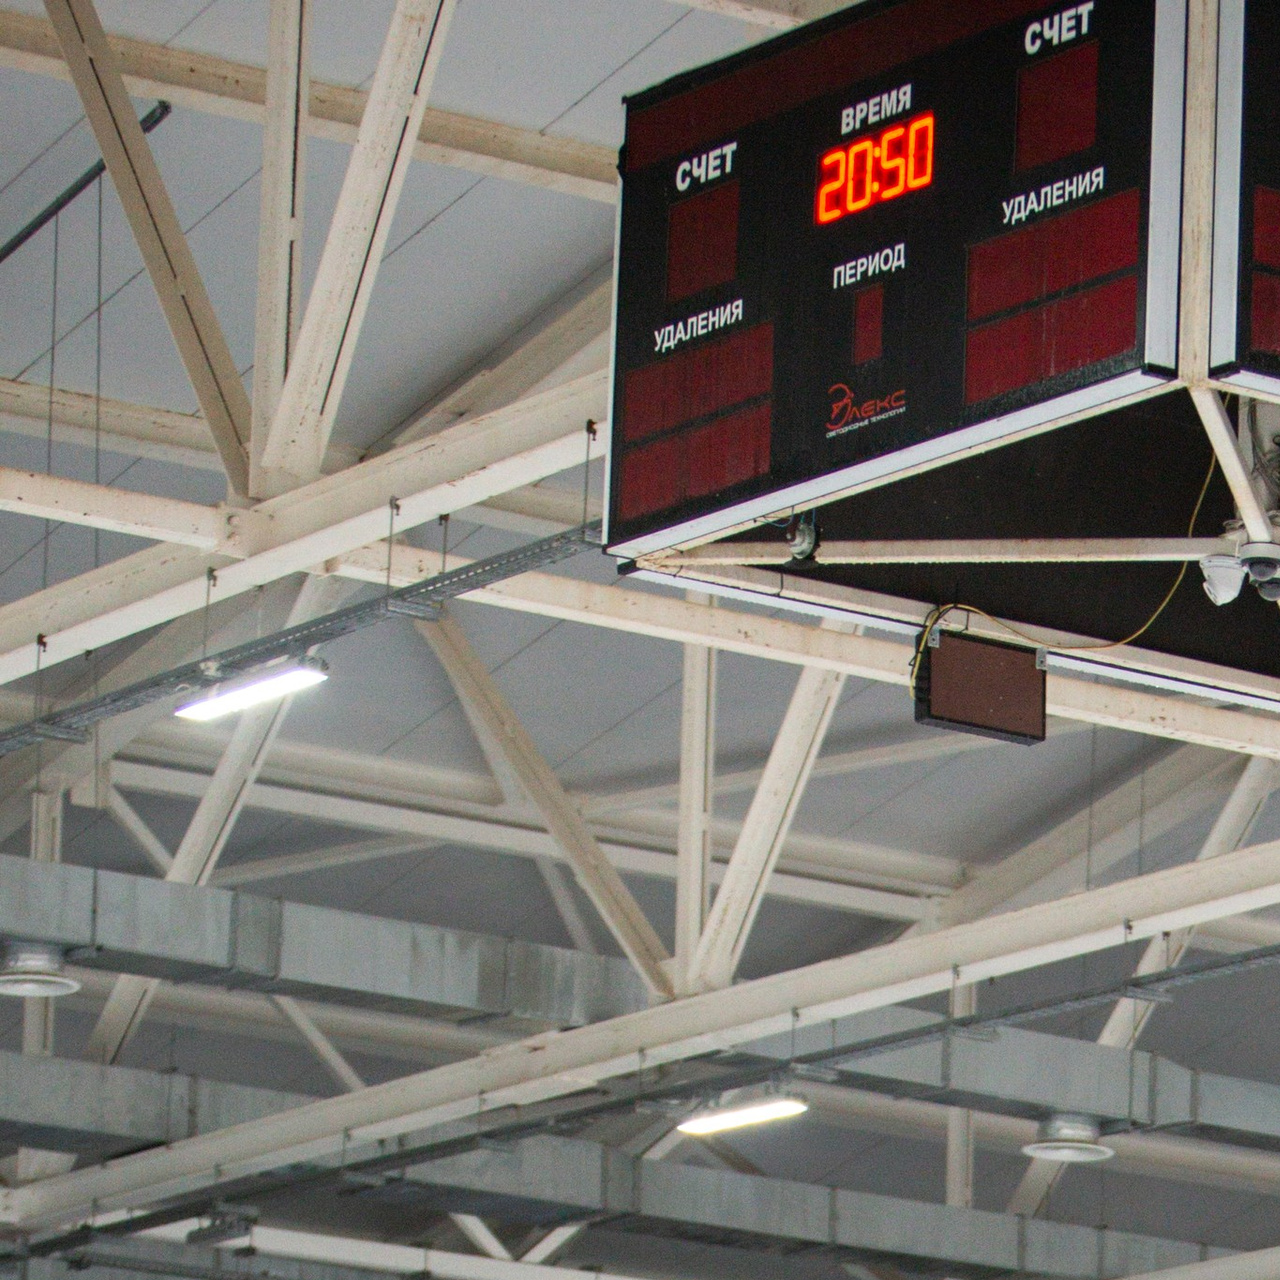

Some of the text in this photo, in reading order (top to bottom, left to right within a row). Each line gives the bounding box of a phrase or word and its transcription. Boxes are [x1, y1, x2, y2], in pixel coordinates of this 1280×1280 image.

[1025, 1, 1094, 55] СЧЕТ
[841, 83, 912, 135] ВРЕМЯ
[675, 141, 738, 192] СЧЕТ
[818, 115, 935, 223] 20:50
[1002, 166, 1105, 226] УДАЛЕНИЯ
[833, 242, 906, 290] ПЕРИОД
[654, 299, 744, 353] УДАЛЕНИЯ
